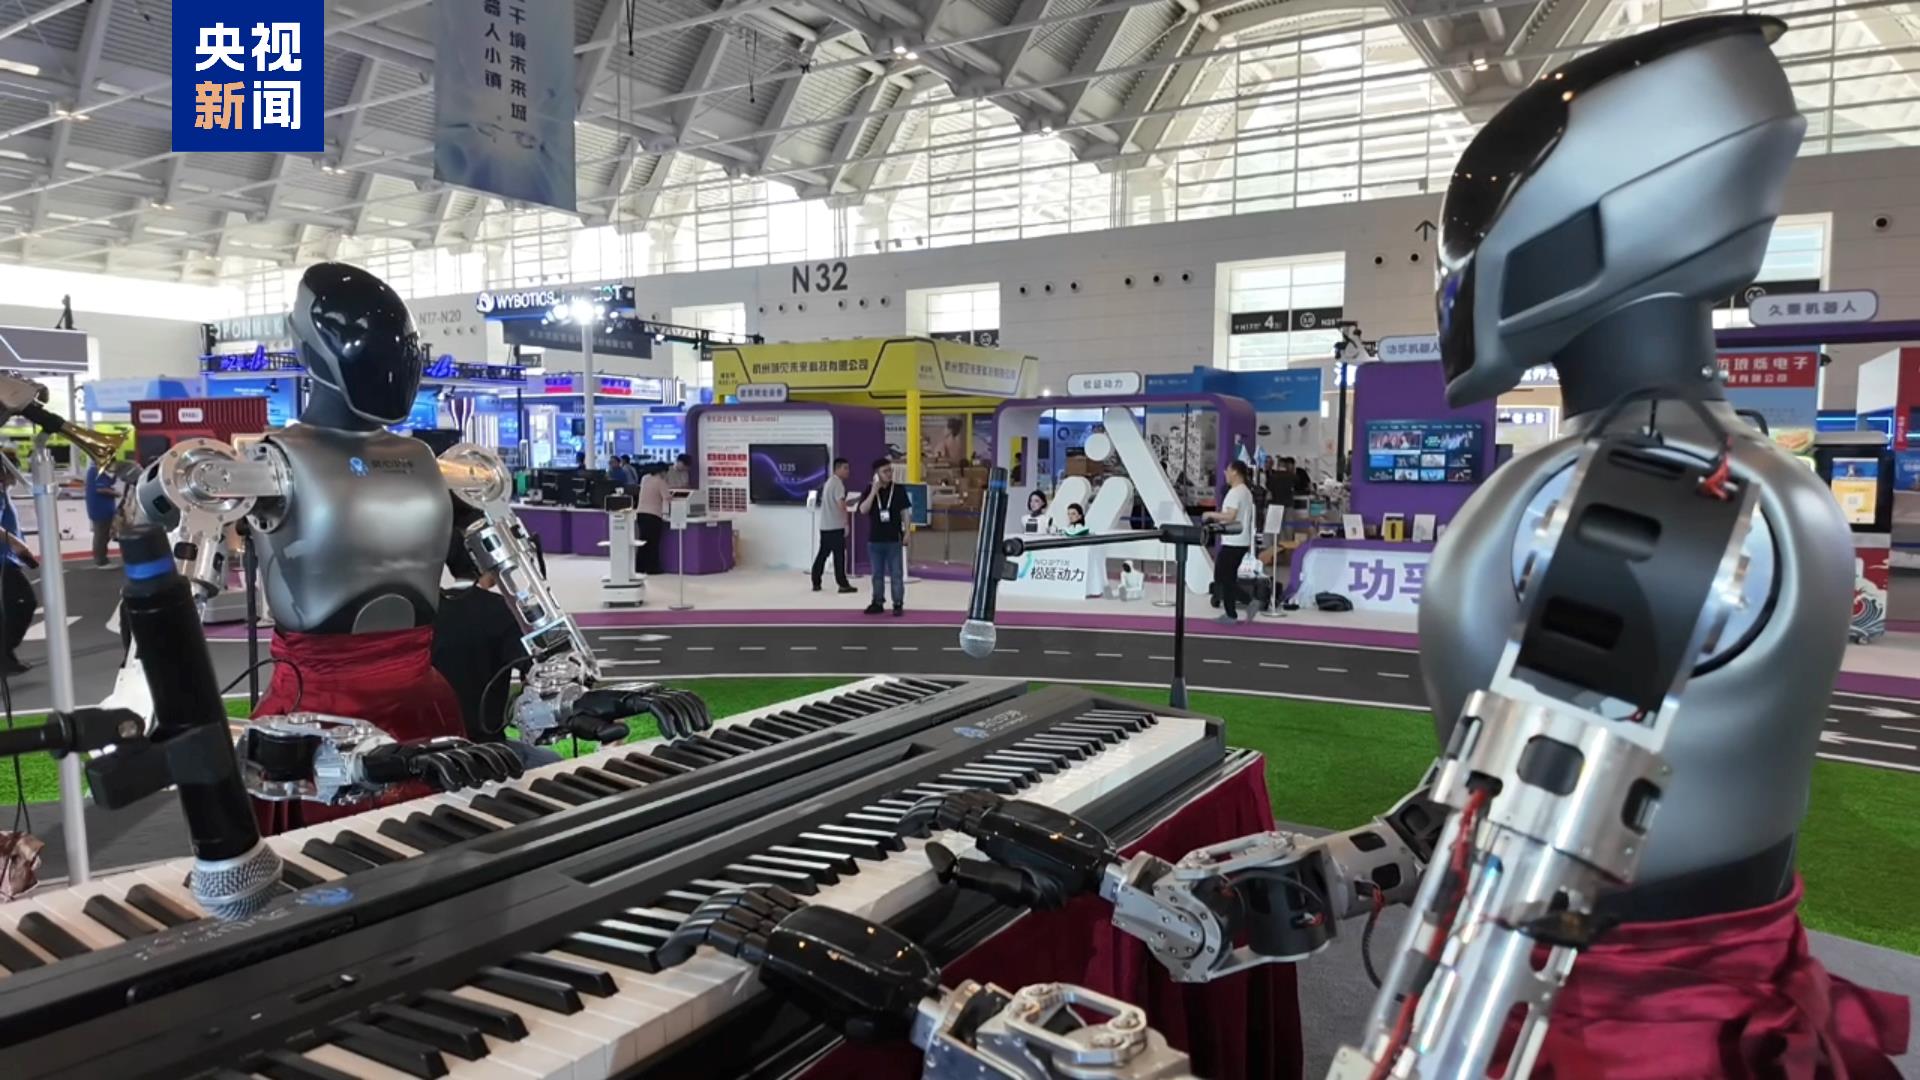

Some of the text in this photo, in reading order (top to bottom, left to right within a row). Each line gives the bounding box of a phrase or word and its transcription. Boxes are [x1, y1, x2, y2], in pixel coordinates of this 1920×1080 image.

[509, 0, 528, 123] 千境未来城
[792, 262, 848, 293] N32
[496, 290, 555, 309] WYBOTICS
[1264, 315, 1275, 329] 4
[1031, 566, 1085, 582] 松延动力
